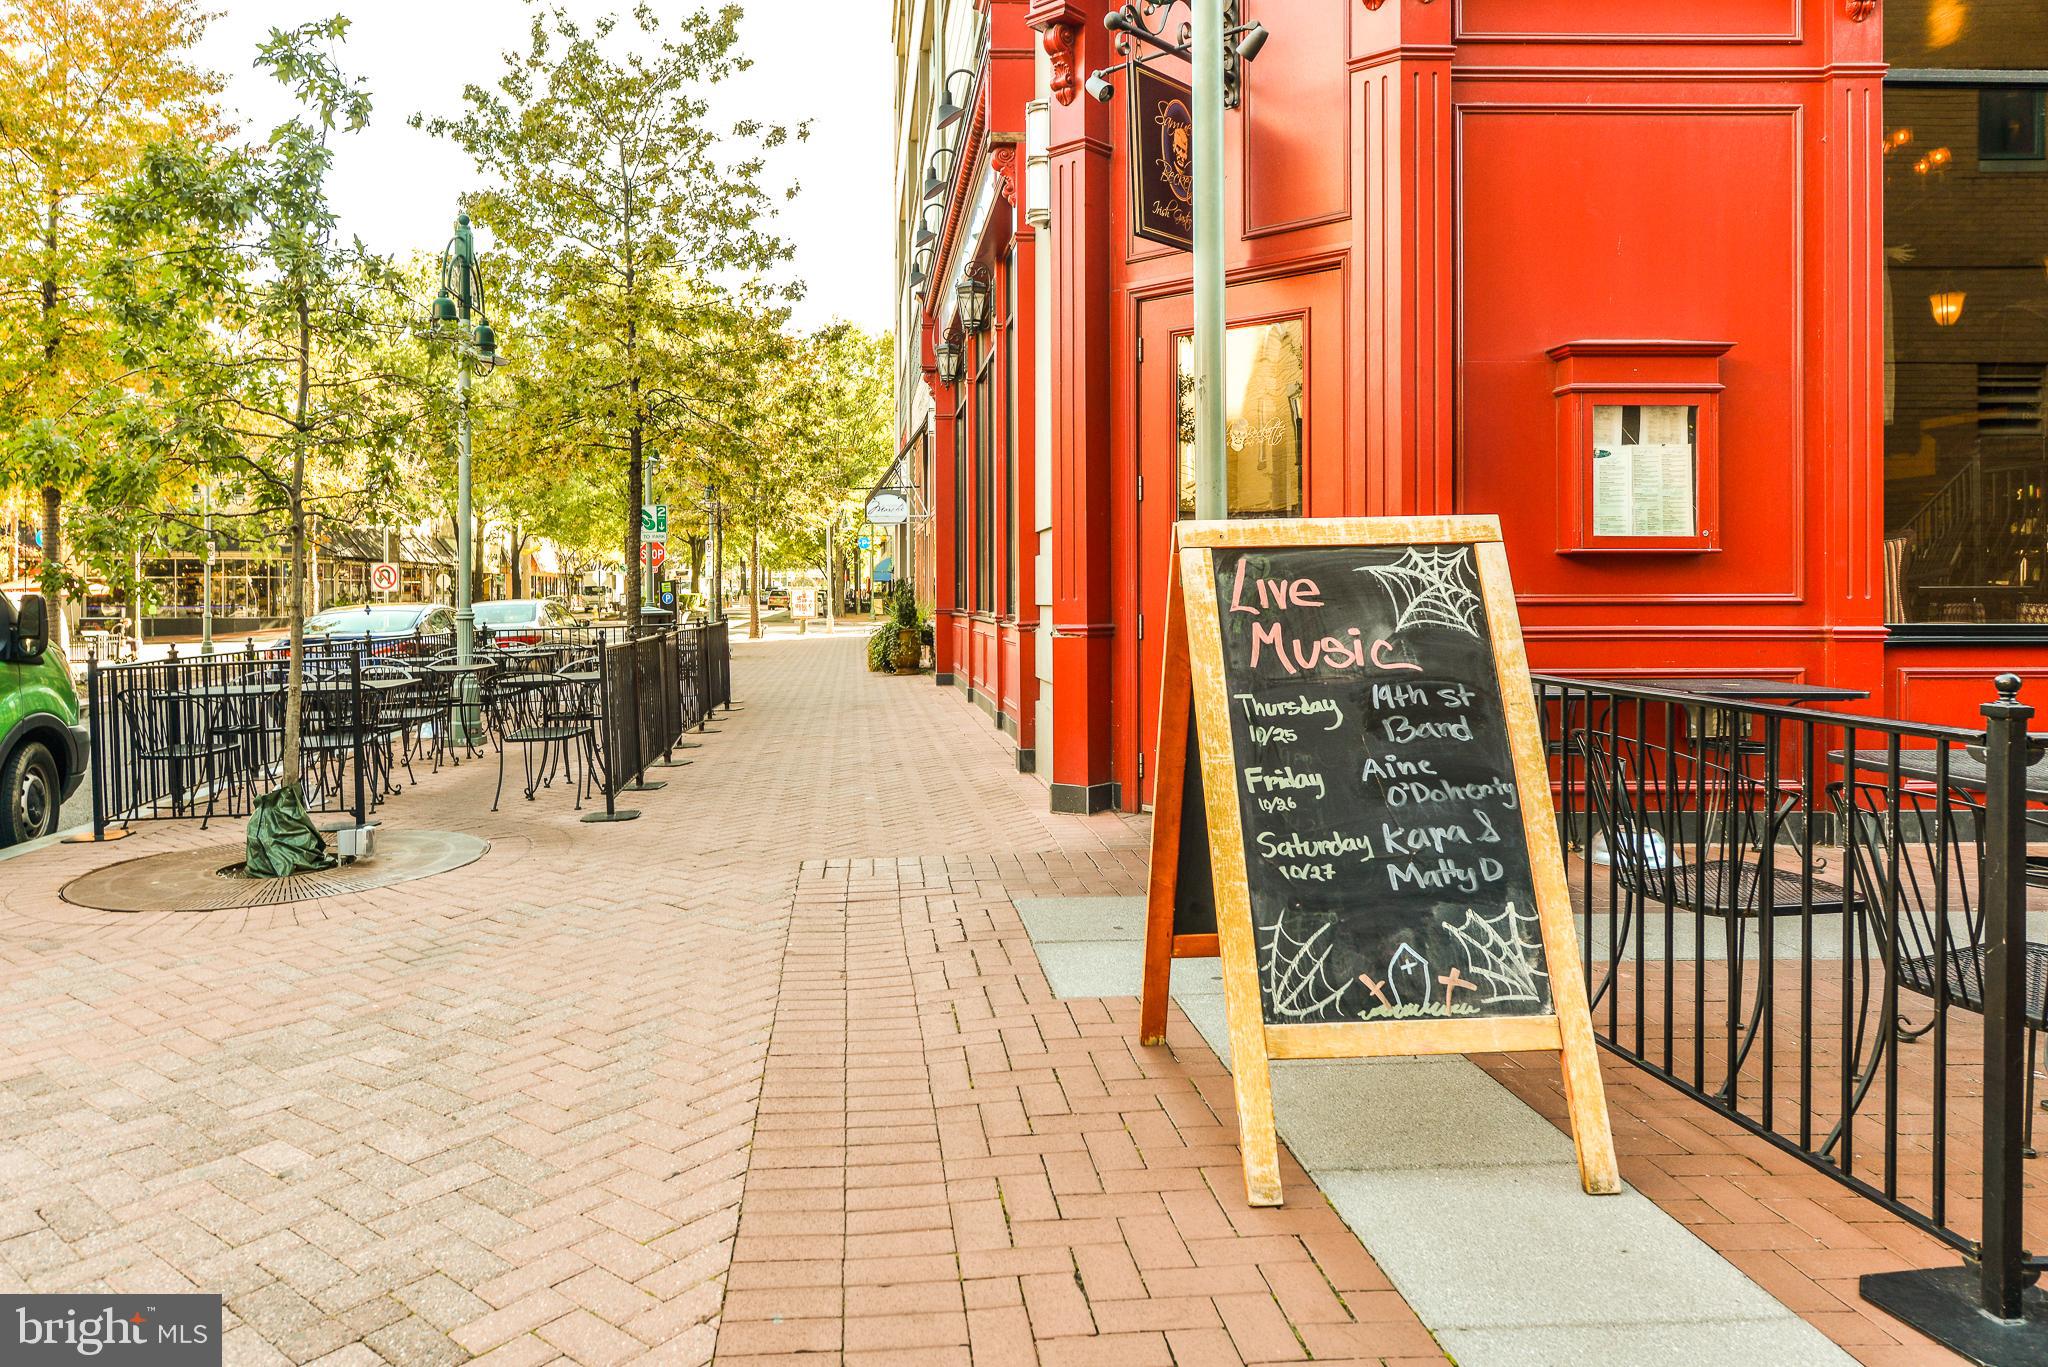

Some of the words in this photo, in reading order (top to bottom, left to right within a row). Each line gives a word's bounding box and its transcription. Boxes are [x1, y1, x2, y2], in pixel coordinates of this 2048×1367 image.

[1152, 200, 1178, 218] Irish
[657, 507, 666, 516] 2
[640, 549, 664, 559] SOP
[1230, 559, 1324, 615] Live
[1250, 621, 1424, 675] Music
[1372, 684, 1429, 709] 19th
[1233, 693, 1344, 731] Thursday
[1249, 724, 1298, 746] 10/25
[1382, 715, 1474, 744] Band
[1361, 754, 1438, 782] Aine
[1244, 766, 1326, 800] Friday
[1258, 796, 1297, 814] 10/26
[1256, 831, 1375, 863] Saturday
[1278, 863, 1337, 882] 10/27
[1386, 858, 1478, 893] Matty
[1479, 857, 1504, 882] D
